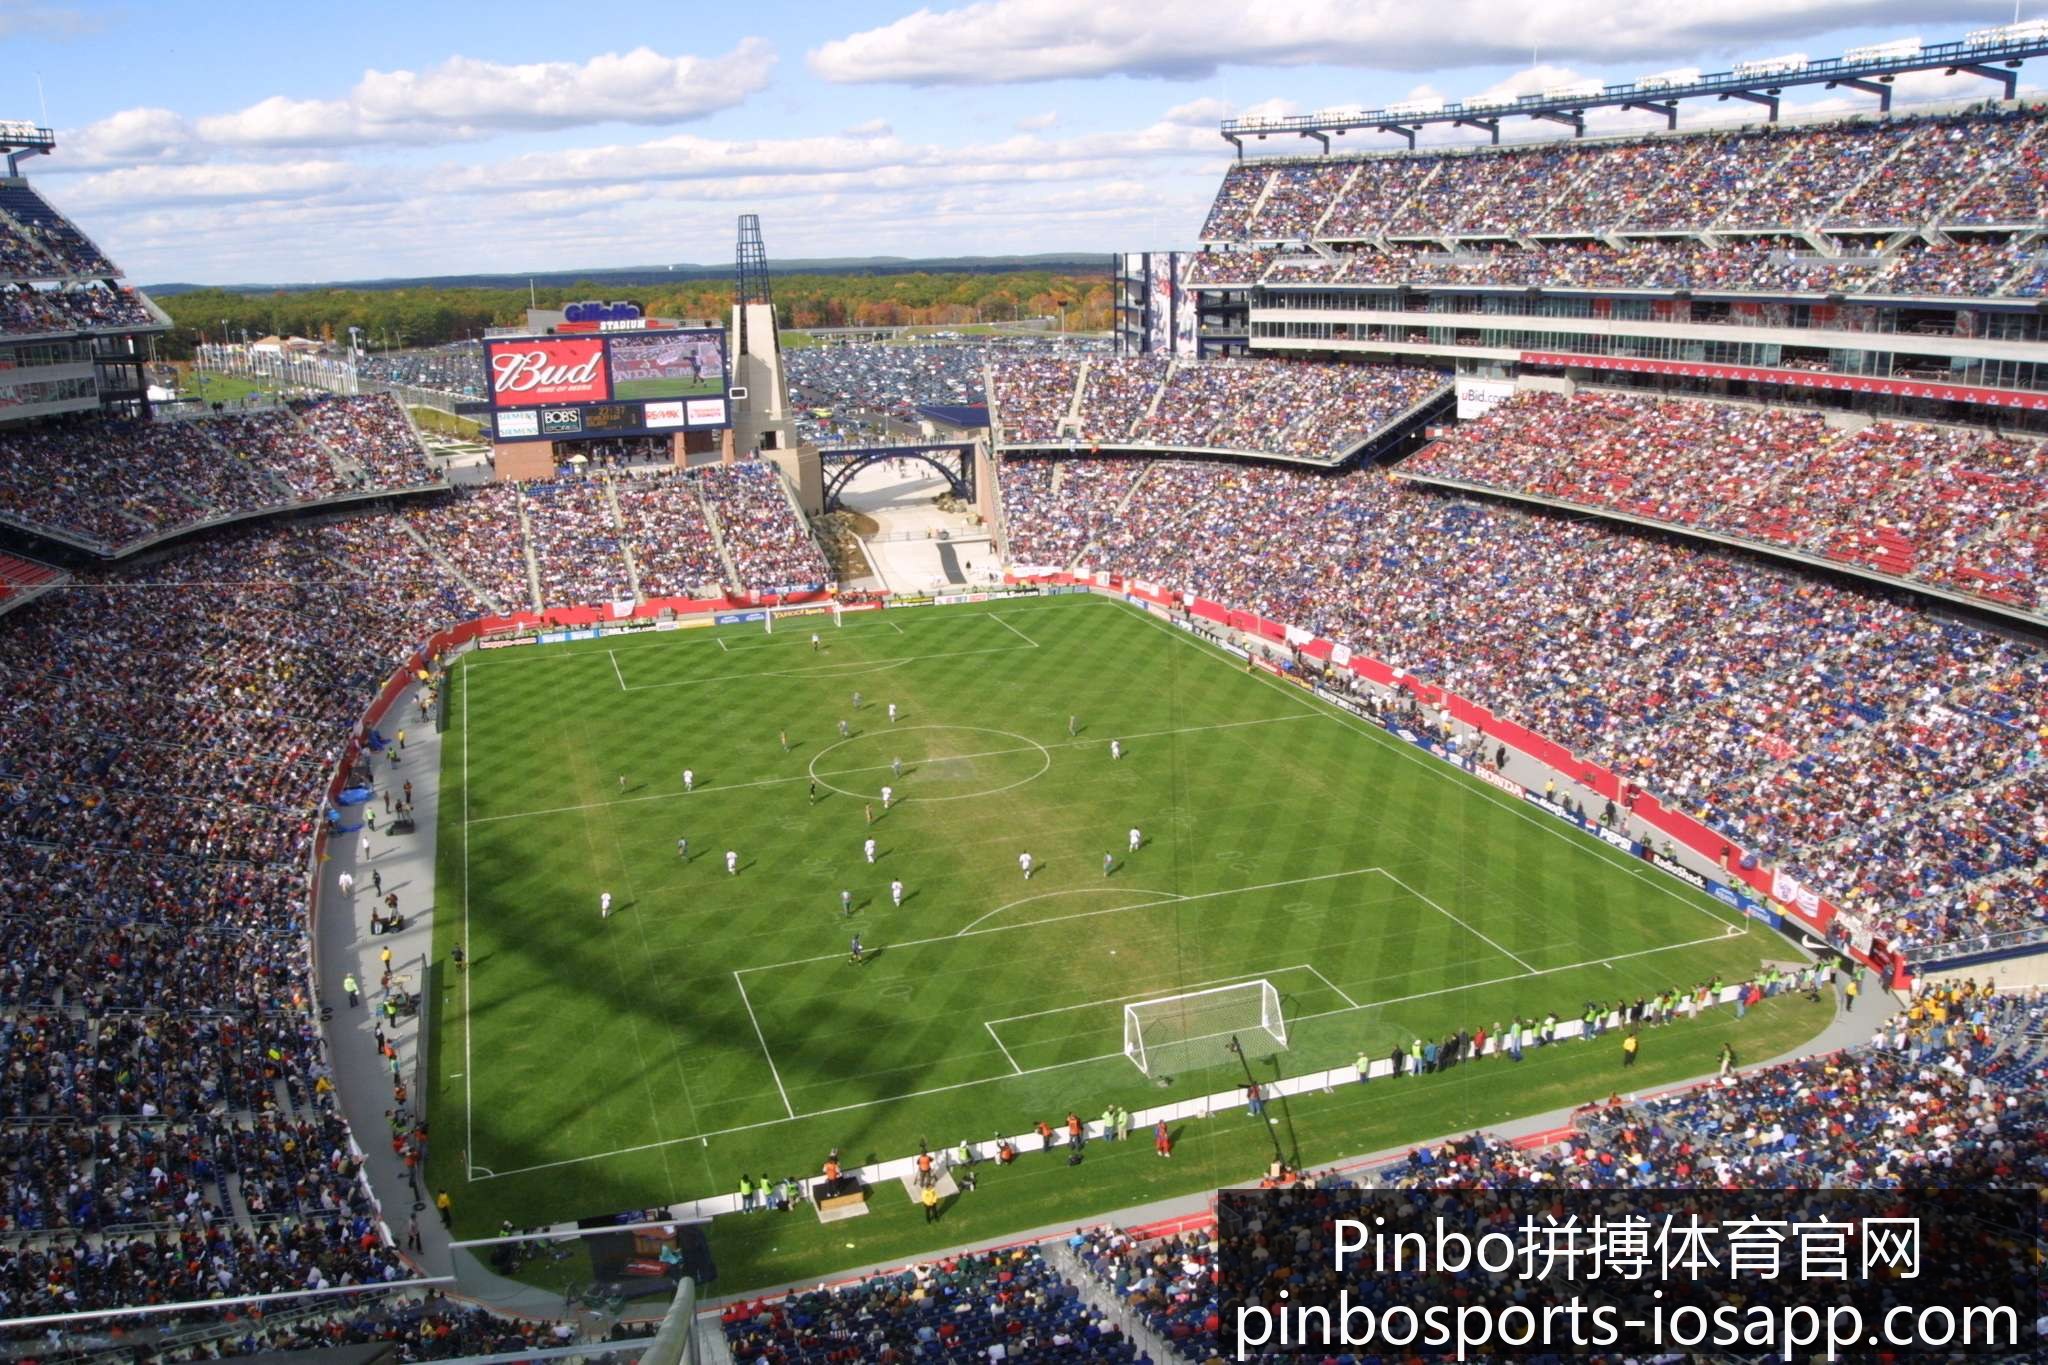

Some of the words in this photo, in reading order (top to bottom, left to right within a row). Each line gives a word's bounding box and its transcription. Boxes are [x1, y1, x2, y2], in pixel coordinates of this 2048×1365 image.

[564, 303, 639, 322] Gillette
[600, 320, 646, 330] STADIUM
[492, 351, 603, 392] Bud
[1475, 764, 1525, 800] HONDA
[1599, 827, 1632, 851] PEPSI
